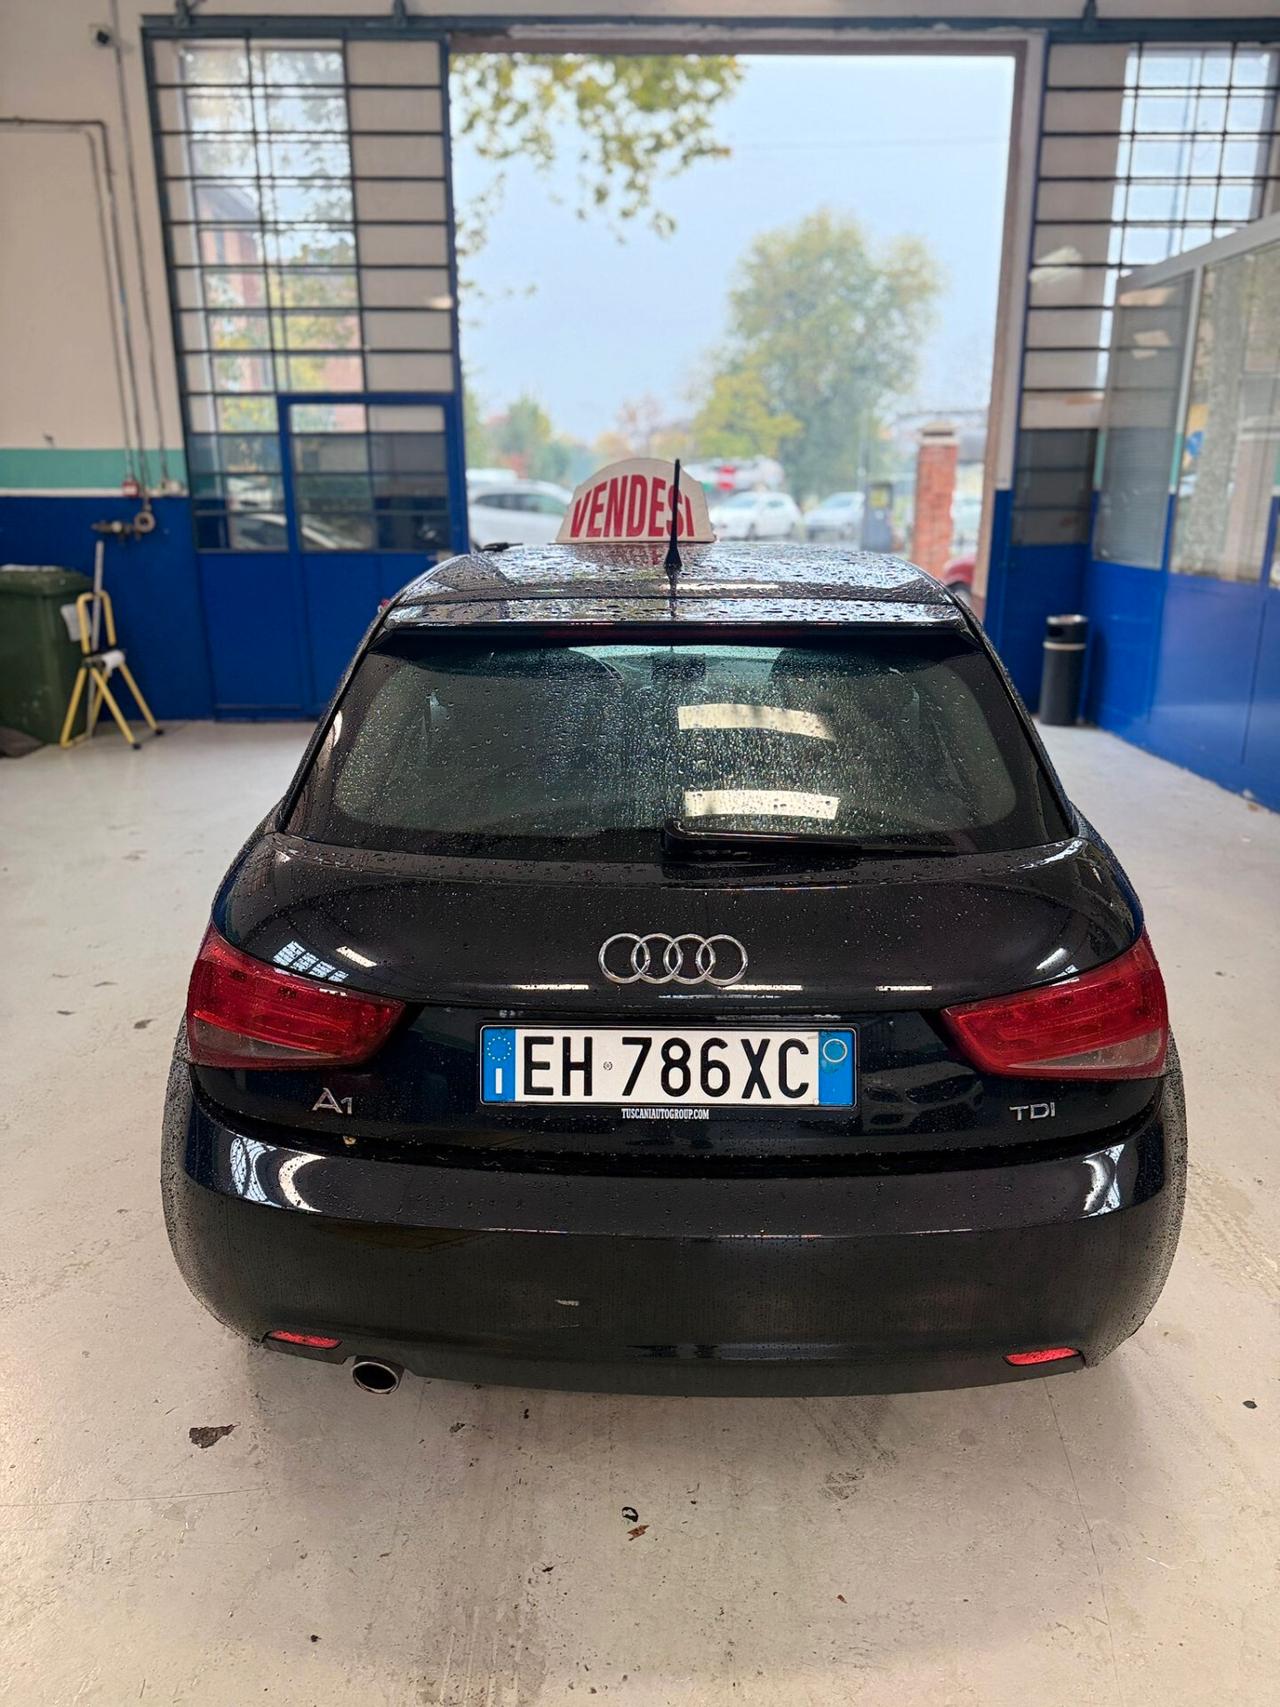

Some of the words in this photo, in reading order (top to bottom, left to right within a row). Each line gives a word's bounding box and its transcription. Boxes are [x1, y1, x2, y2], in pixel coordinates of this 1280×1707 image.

[570, 474, 695, 538] VENDESI
[523, 1036, 593, 1097] EH
[621, 1036, 809, 1099] 786XC
[312, 1087, 353, 1115] A1
[621, 1108, 710, 1120] TUSCANIAUTOGROUP.COM
[1009, 1102, 1056, 1121] TDI
